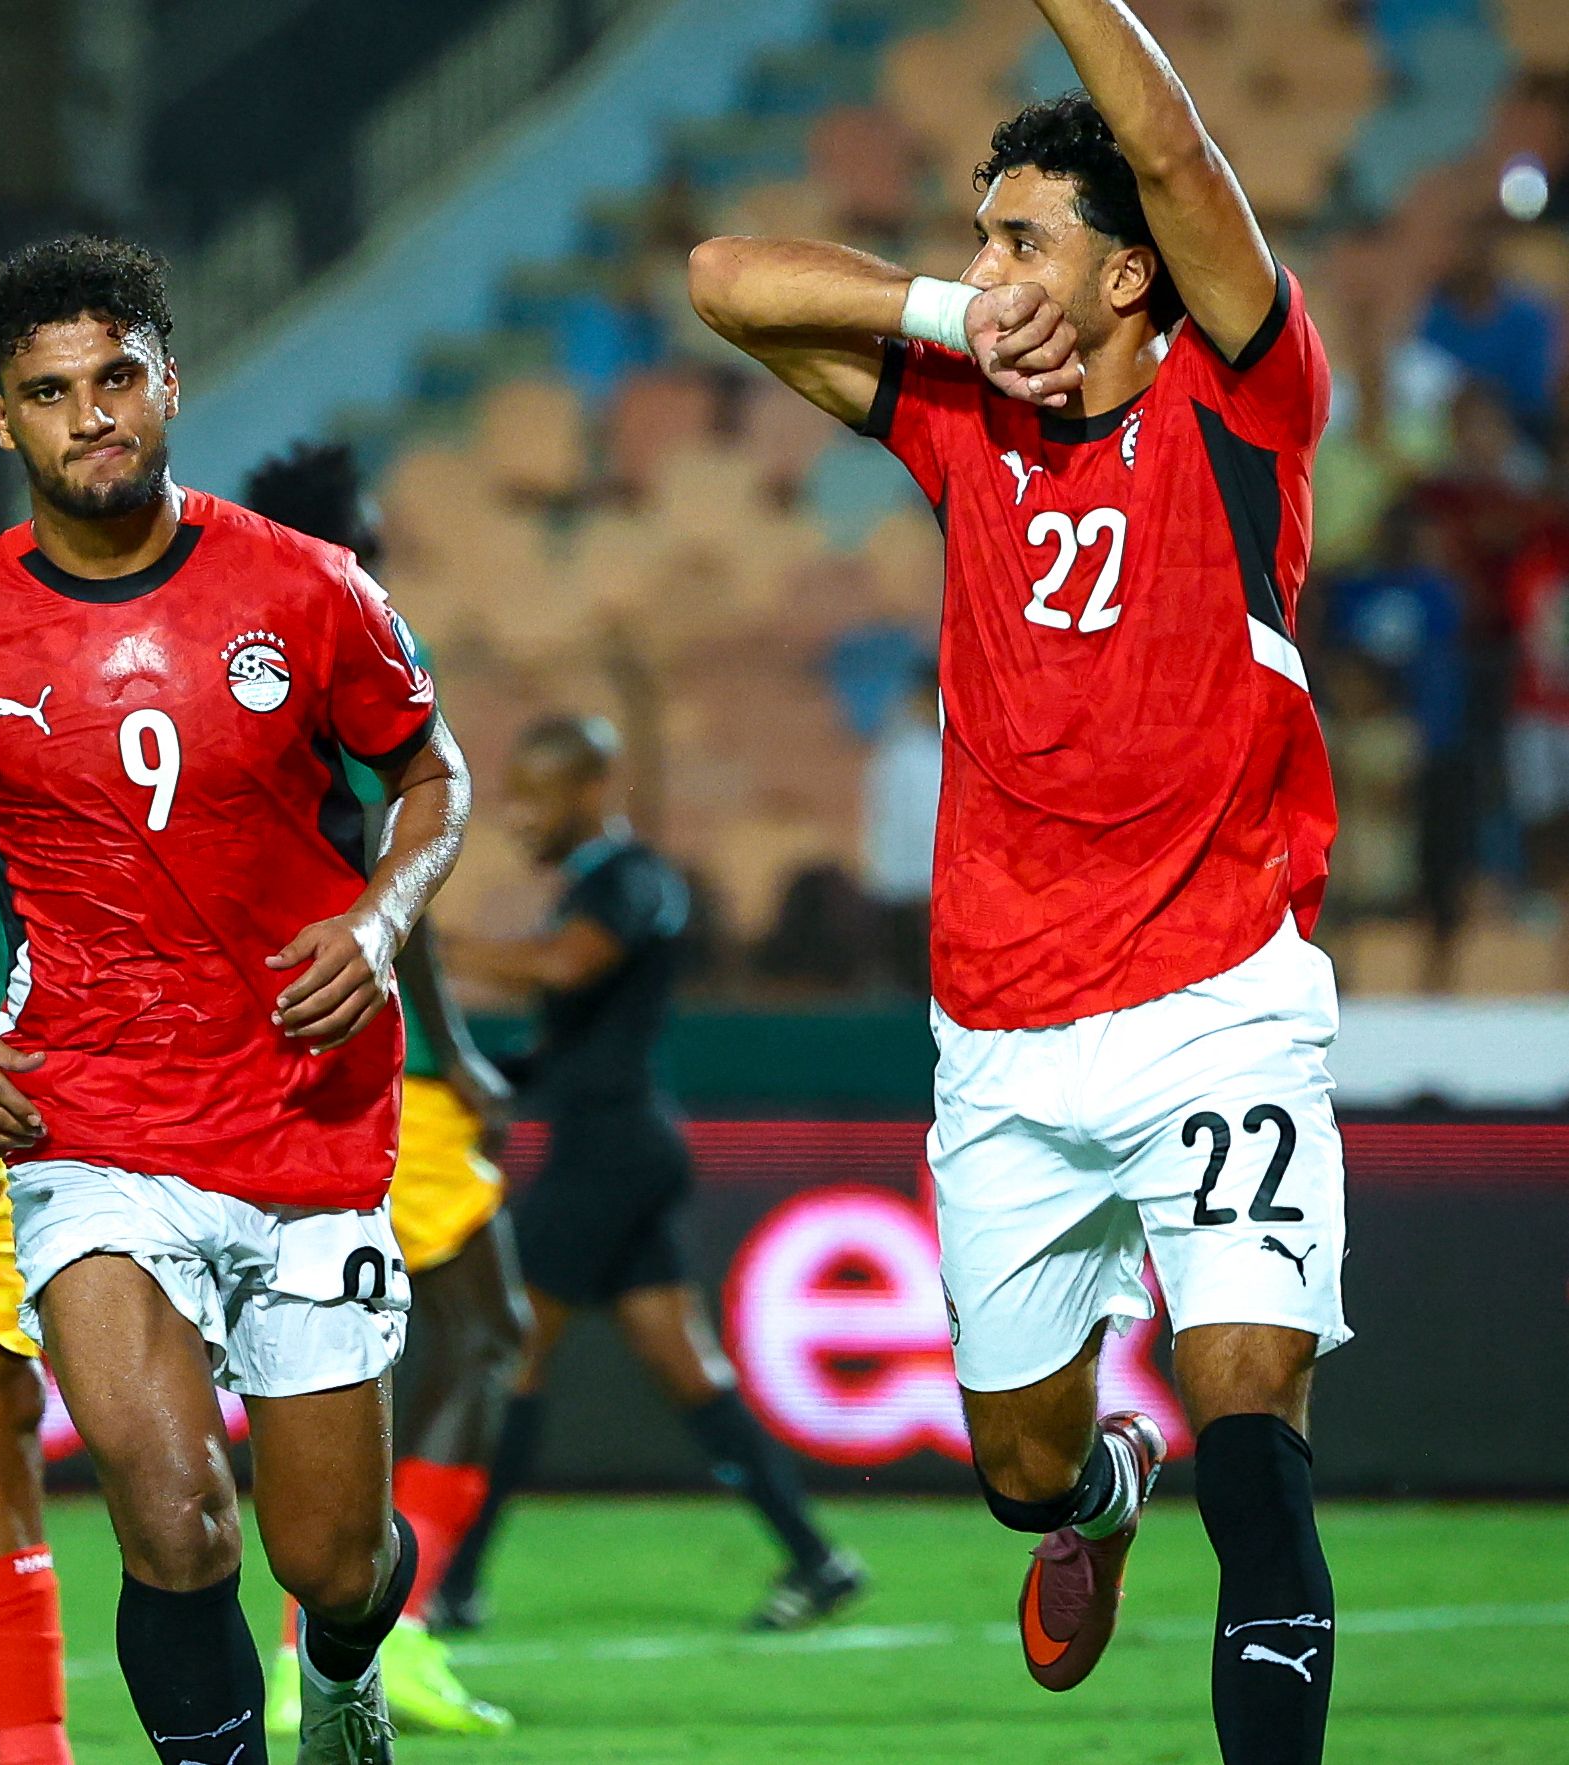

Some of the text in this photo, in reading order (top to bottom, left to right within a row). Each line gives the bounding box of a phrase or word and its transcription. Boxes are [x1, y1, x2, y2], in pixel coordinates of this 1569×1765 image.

[1023, 507, 1128, 633] 22
[119, 708, 181, 832] 9
[1182, 1104, 1305, 1226] 22
